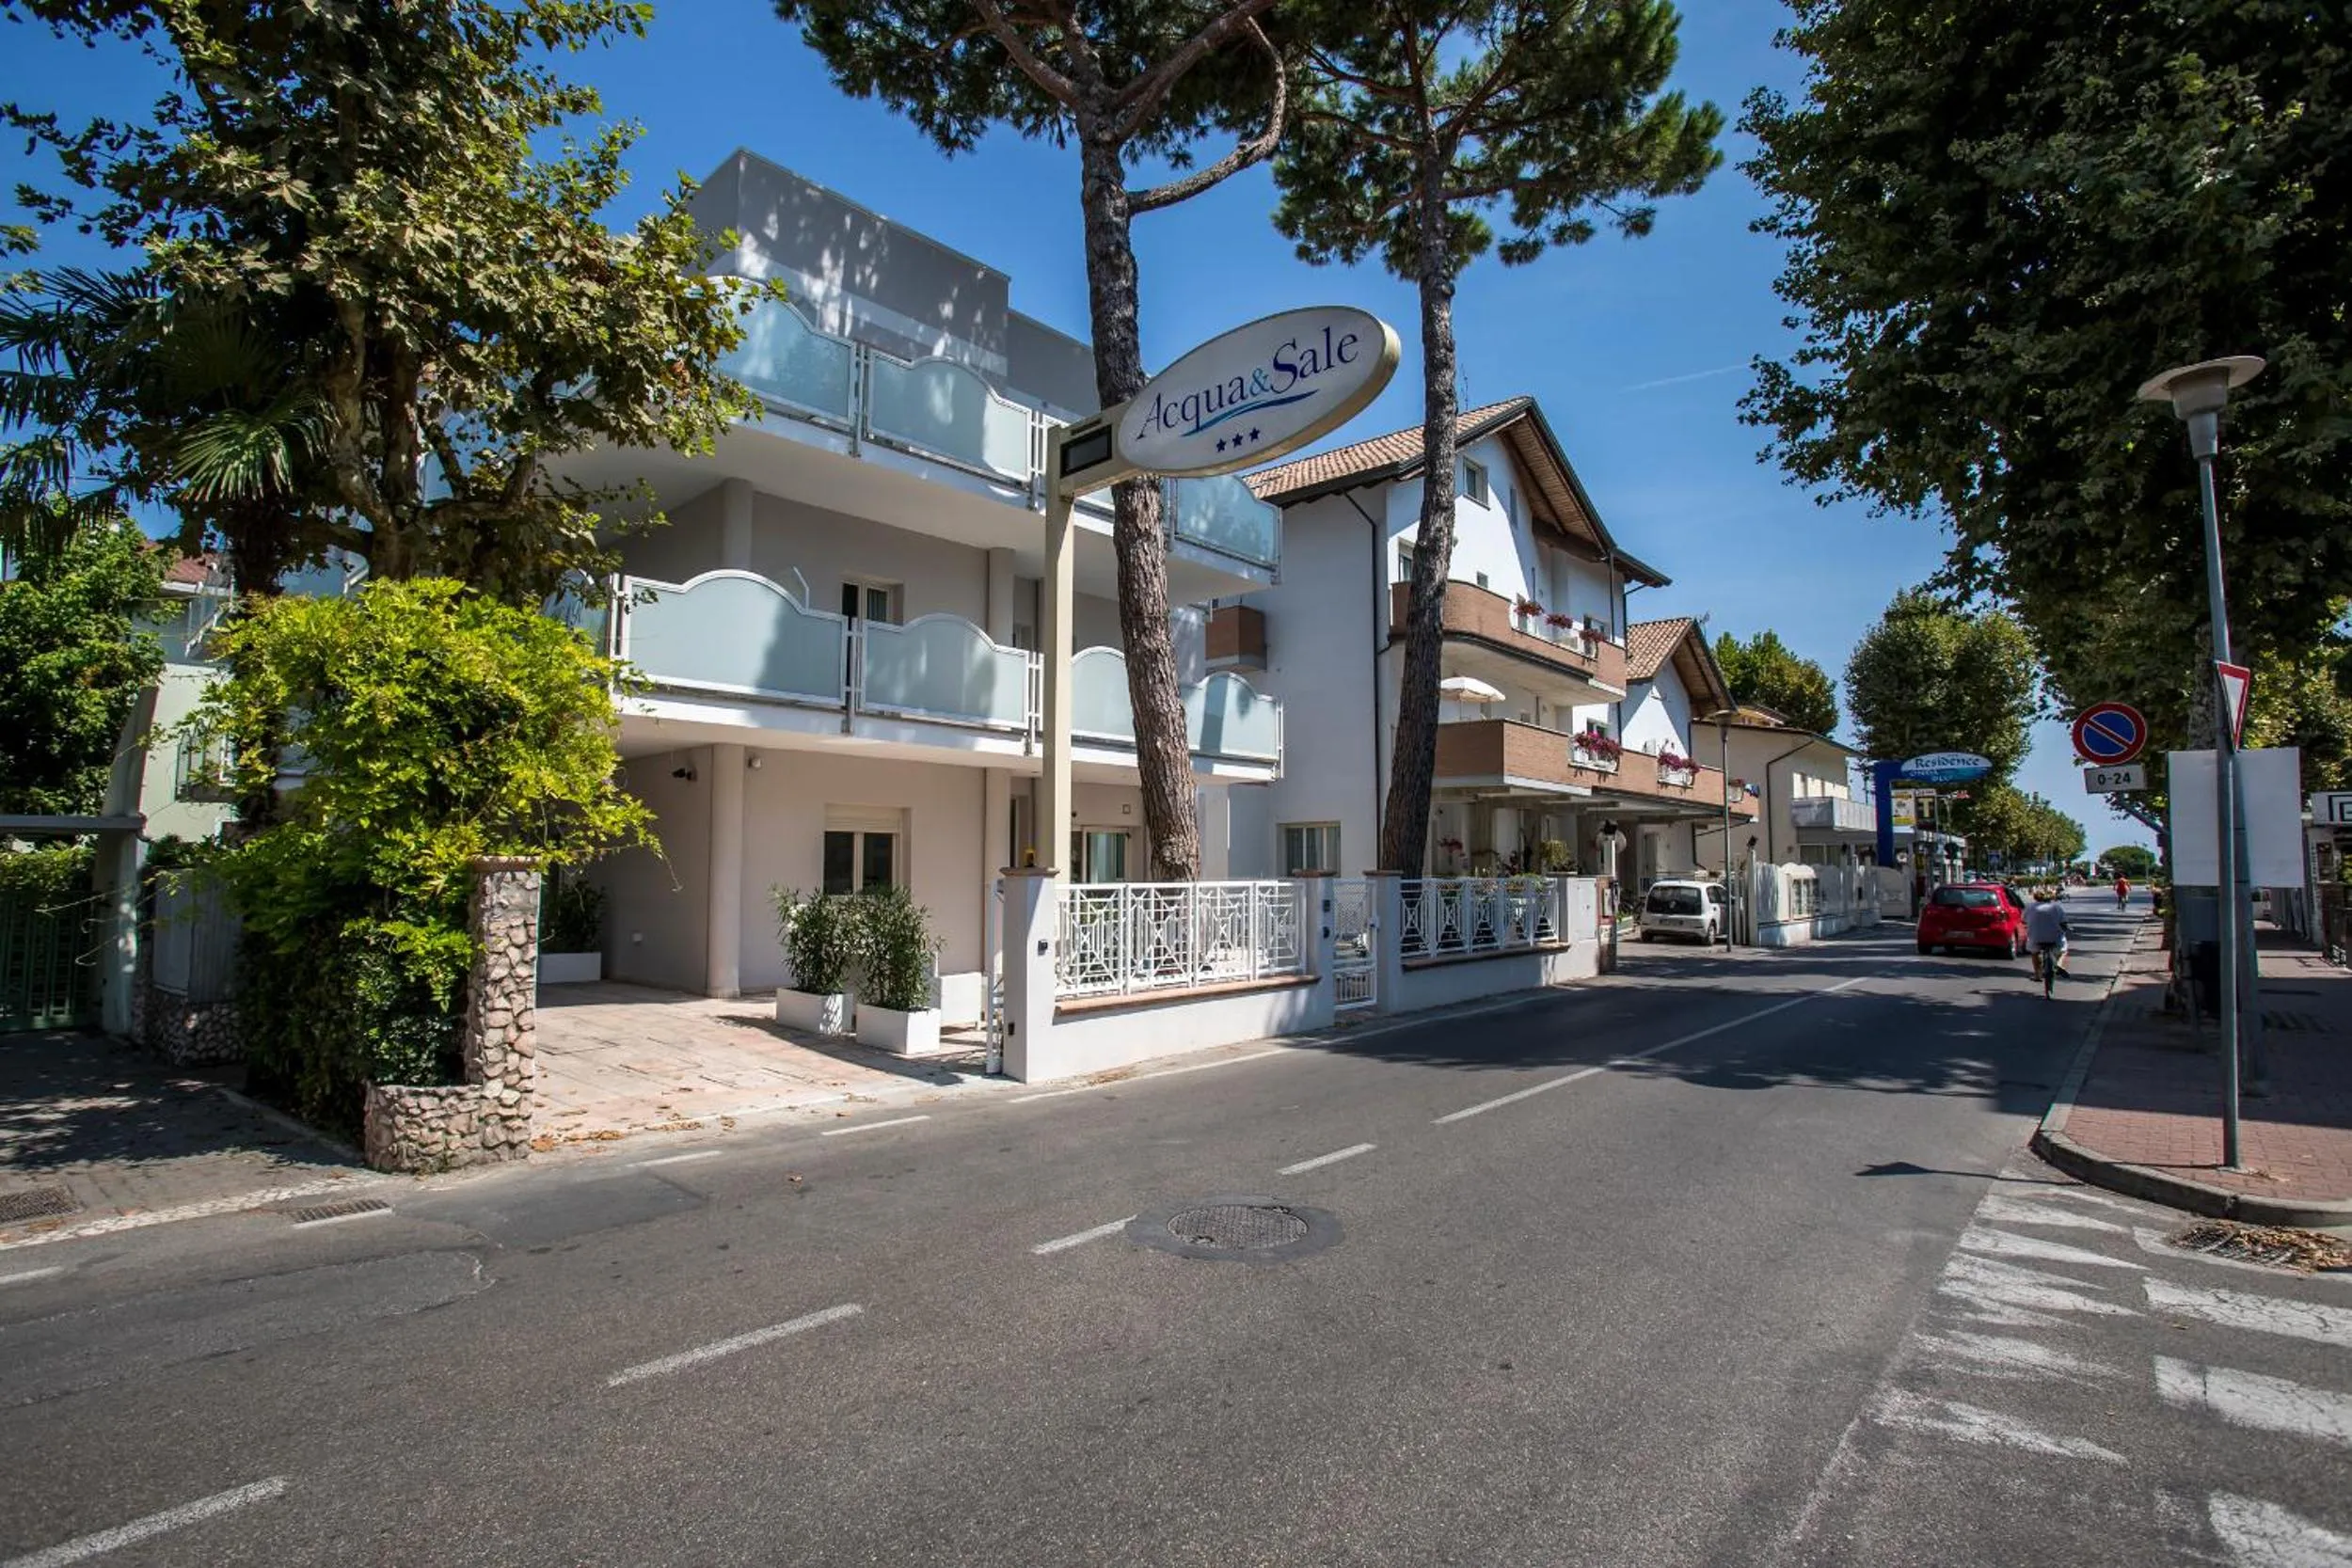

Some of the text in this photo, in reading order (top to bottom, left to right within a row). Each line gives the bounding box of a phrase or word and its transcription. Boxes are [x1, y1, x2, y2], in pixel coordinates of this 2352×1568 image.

[1136, 326, 1359, 439] Acqua&Sale
[1915, 757, 1979, 768] Residence
[2098, 772, 2131, 785] 0-24
